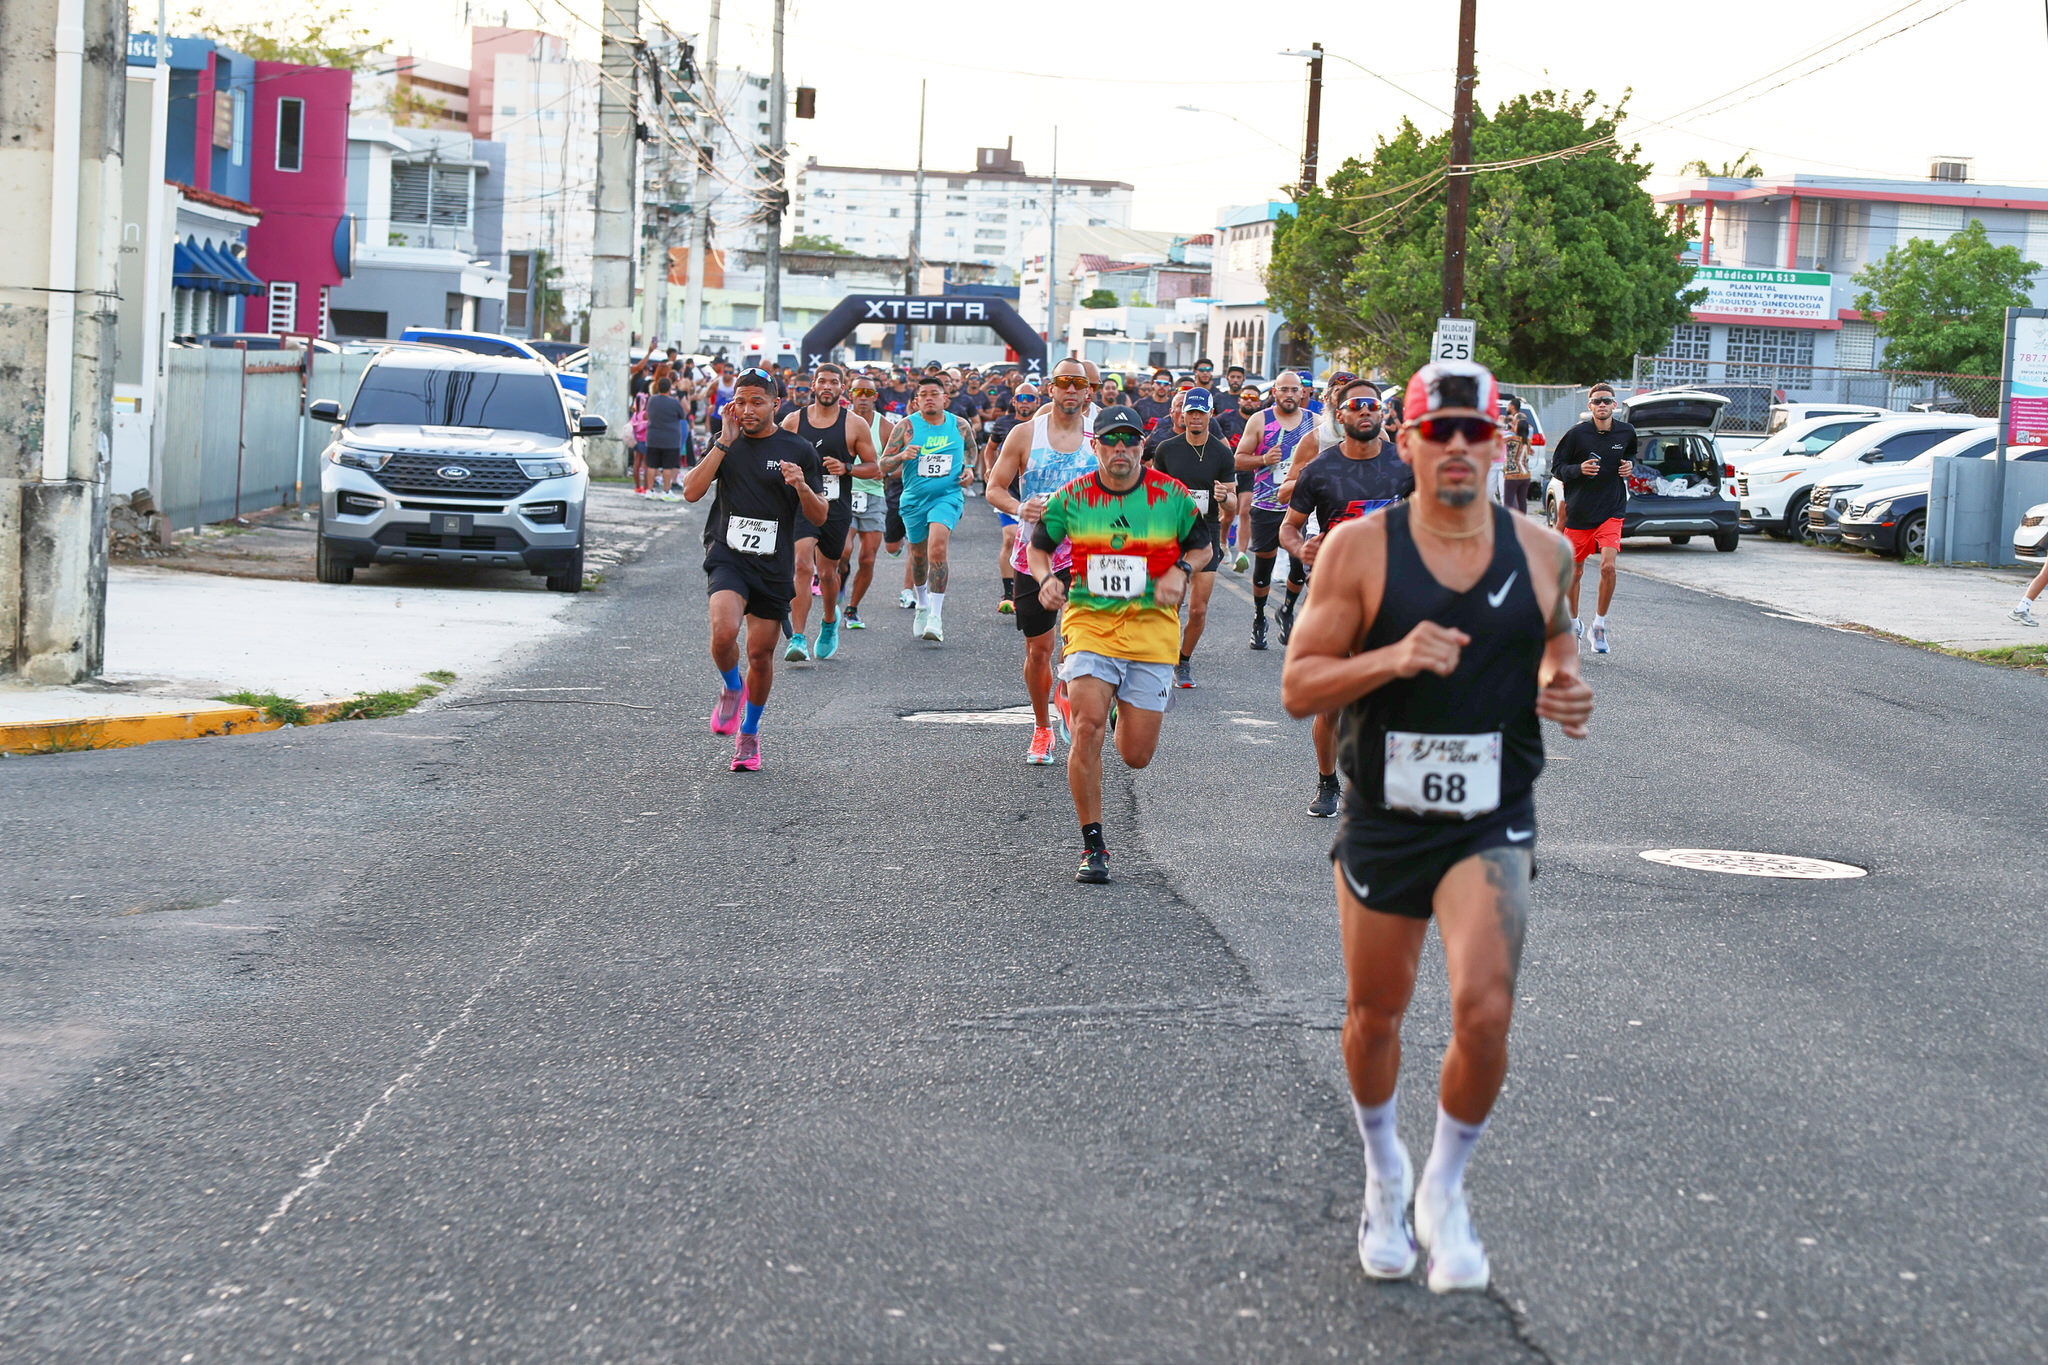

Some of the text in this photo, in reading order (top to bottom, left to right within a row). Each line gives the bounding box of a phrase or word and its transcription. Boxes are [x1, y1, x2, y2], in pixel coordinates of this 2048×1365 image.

[1715, 269, 1754, 280] Médico
[1756, 272, 1774, 281] IPA
[1777, 273, 1796, 282] 513
[1442, 334, 1469, 342] MAXIMA
[1440, 343, 1469, 360] 25
[926, 435, 949, 448] RUN
[928, 464, 941, 474] 53
[741, 533, 761, 549] 72
[1101, 574, 1131, 592] 181
[1421, 771, 1467, 805] 68
